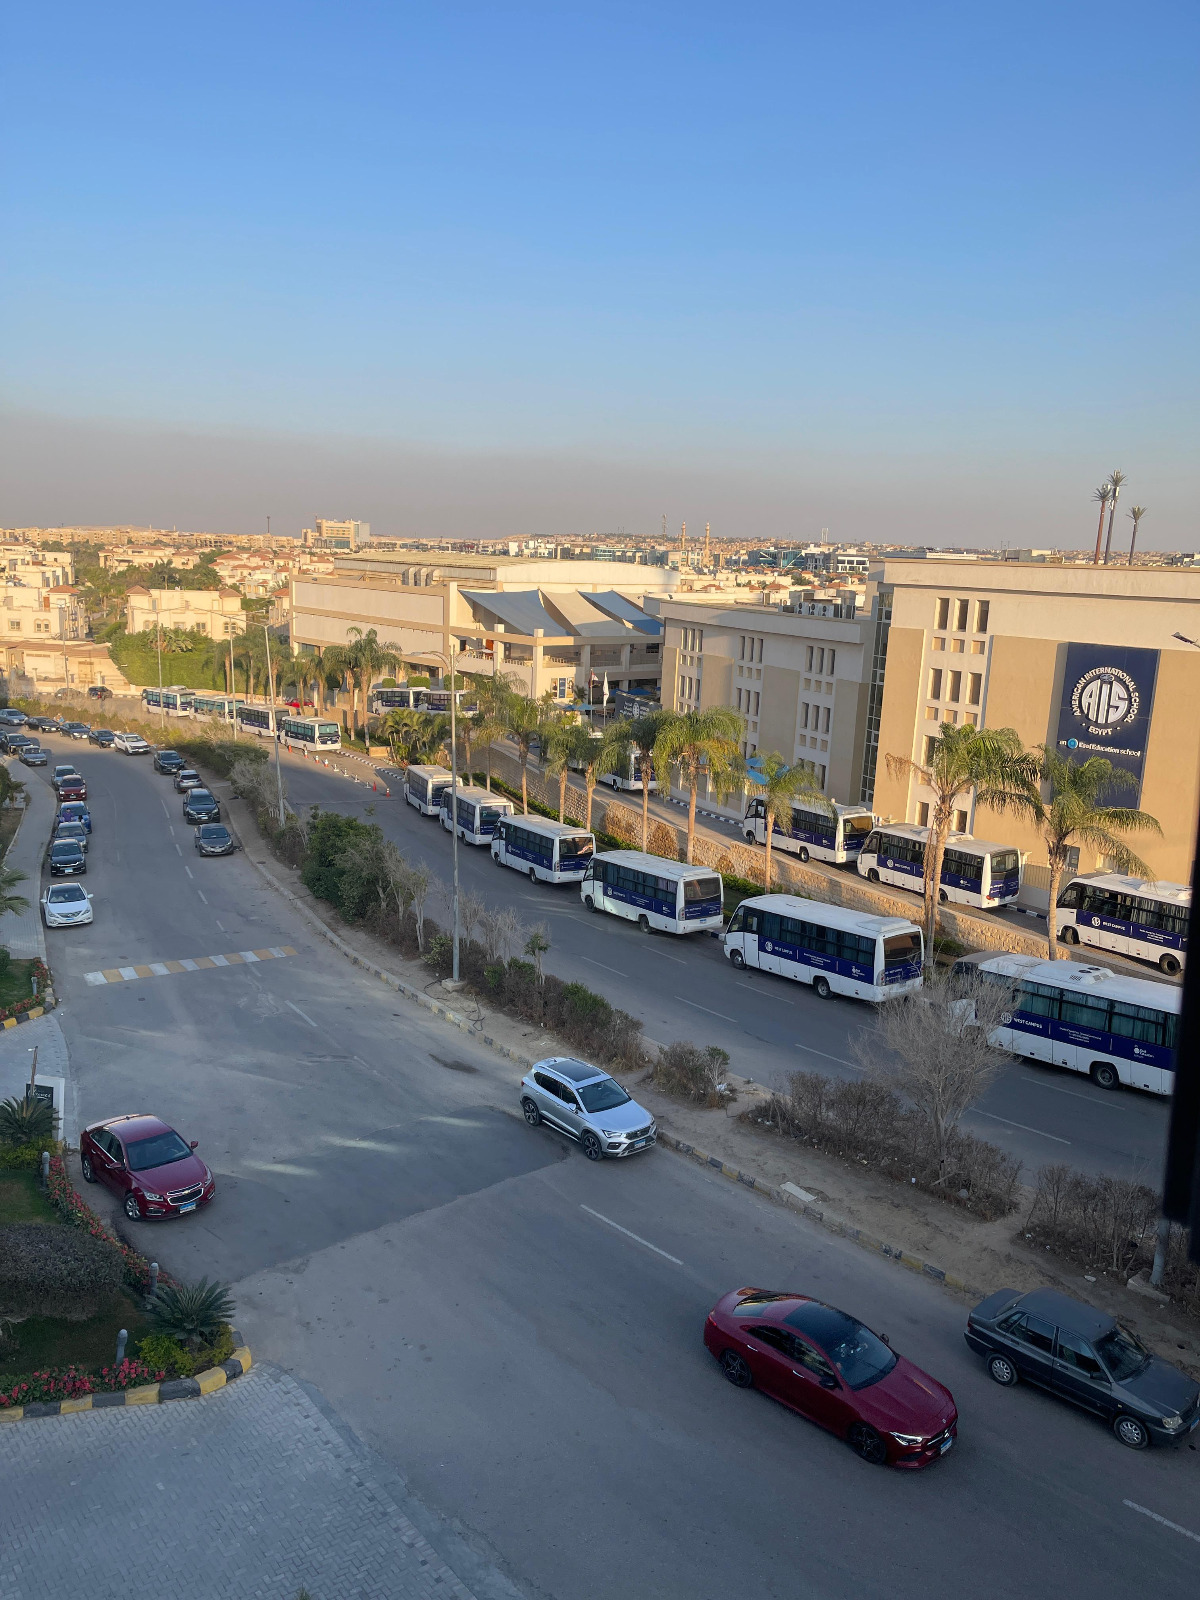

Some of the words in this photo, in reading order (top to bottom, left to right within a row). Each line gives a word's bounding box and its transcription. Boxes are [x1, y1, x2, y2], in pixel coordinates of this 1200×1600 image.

[1072, 678, 1087, 716] AMERICAN
[1084, 667, 1137, 692] INTERNATIONAL
[1124, 692, 1140, 723] SCHOOL
[1081, 679, 1129, 724] AIS
[1088, 725, 1113, 736] EGYPT
[1119, 748, 1141, 758] school
